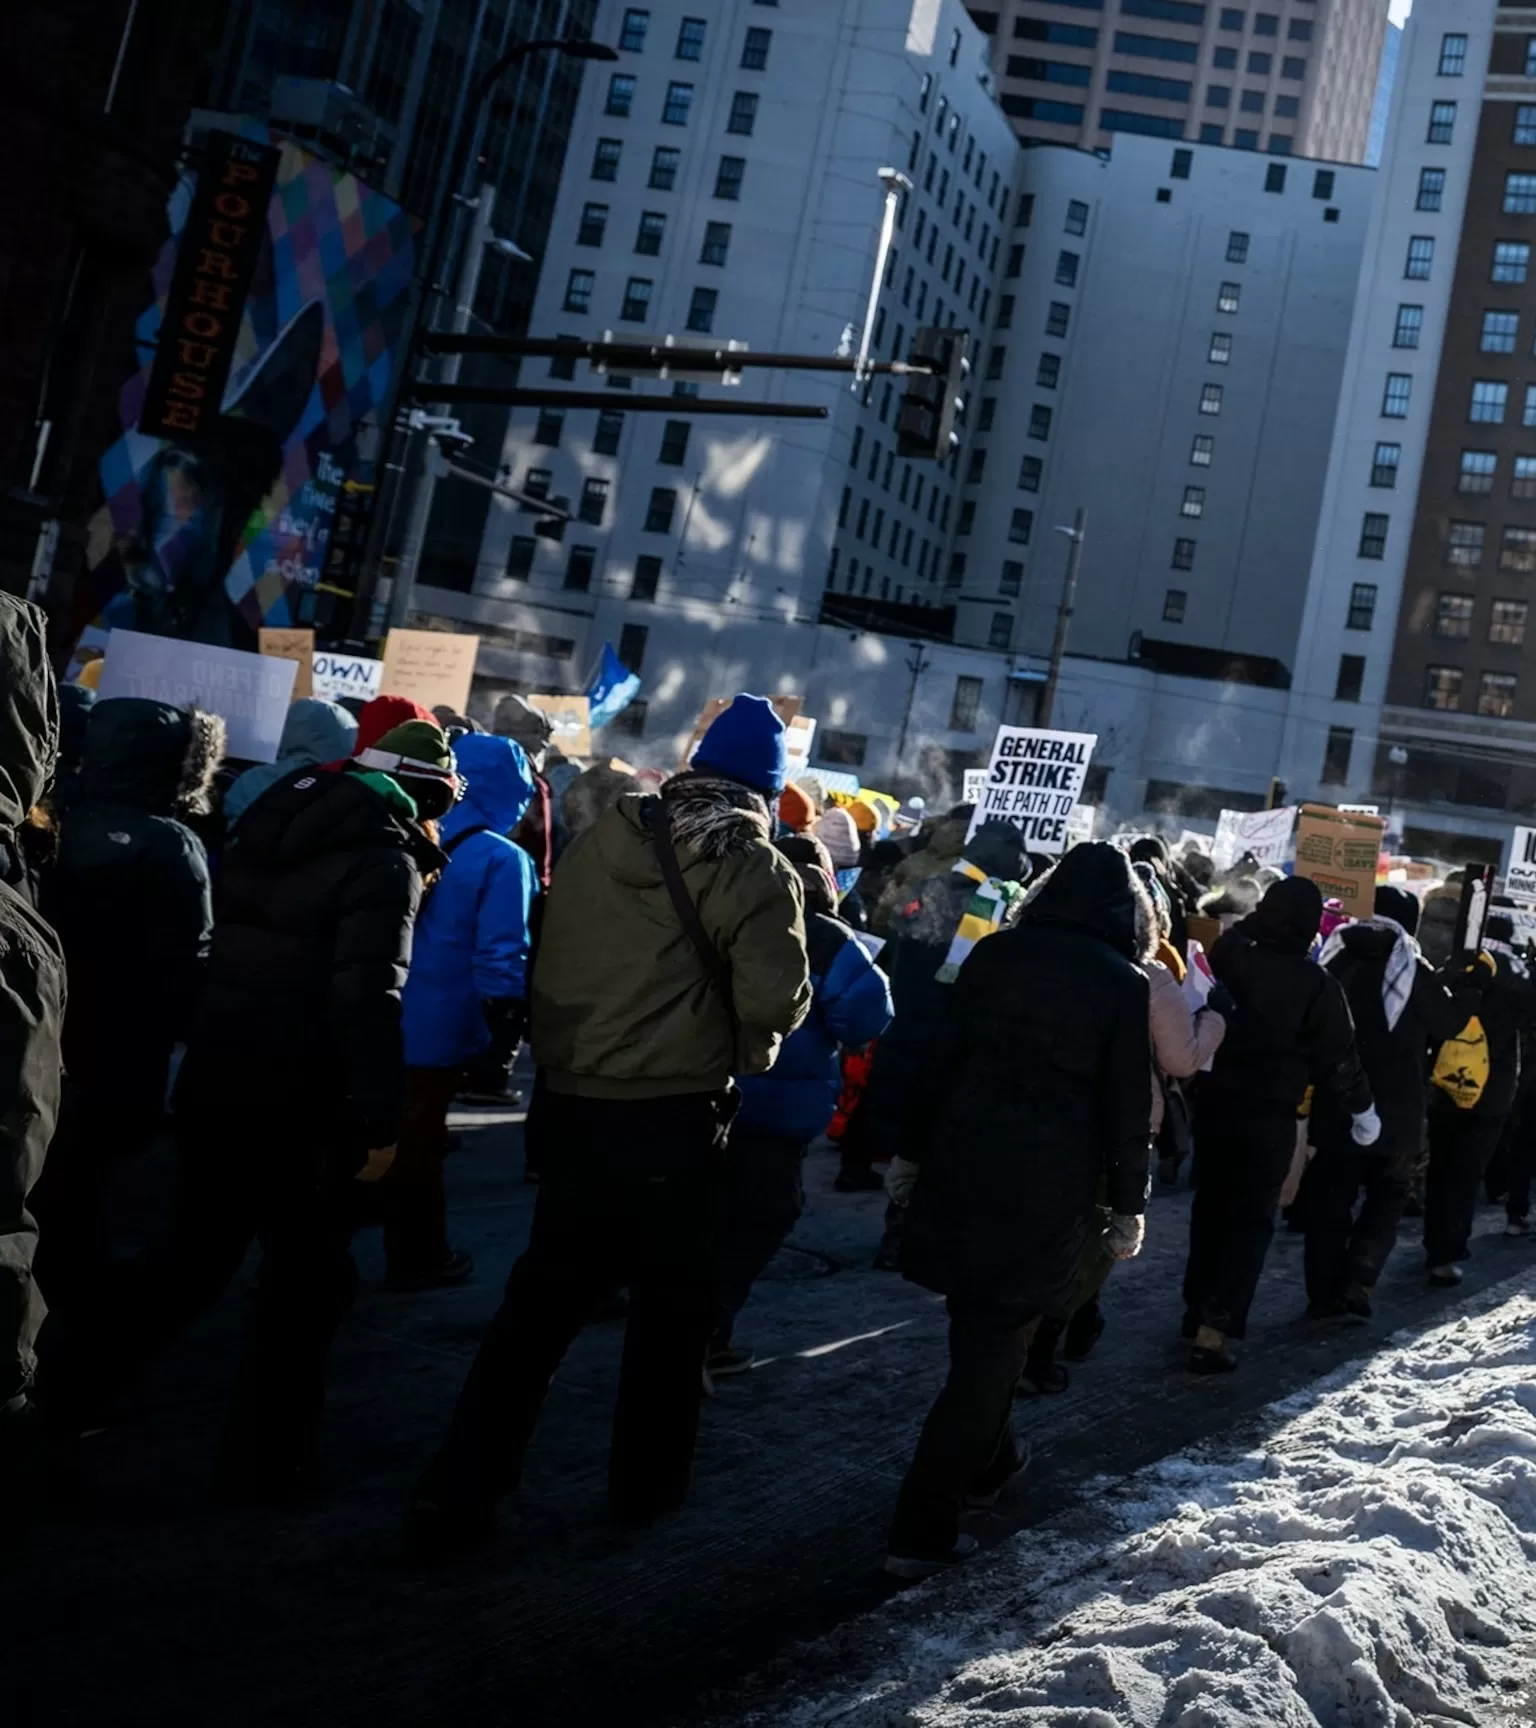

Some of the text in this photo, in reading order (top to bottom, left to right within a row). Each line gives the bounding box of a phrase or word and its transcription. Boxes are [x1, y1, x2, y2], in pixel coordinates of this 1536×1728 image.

[160, 158, 261, 432] POURHOUSE
[999, 736, 1085, 764] GENERAL
[990, 760, 1080, 791] STRIKE:
[984, 788, 1074, 816] THE PATH TO
